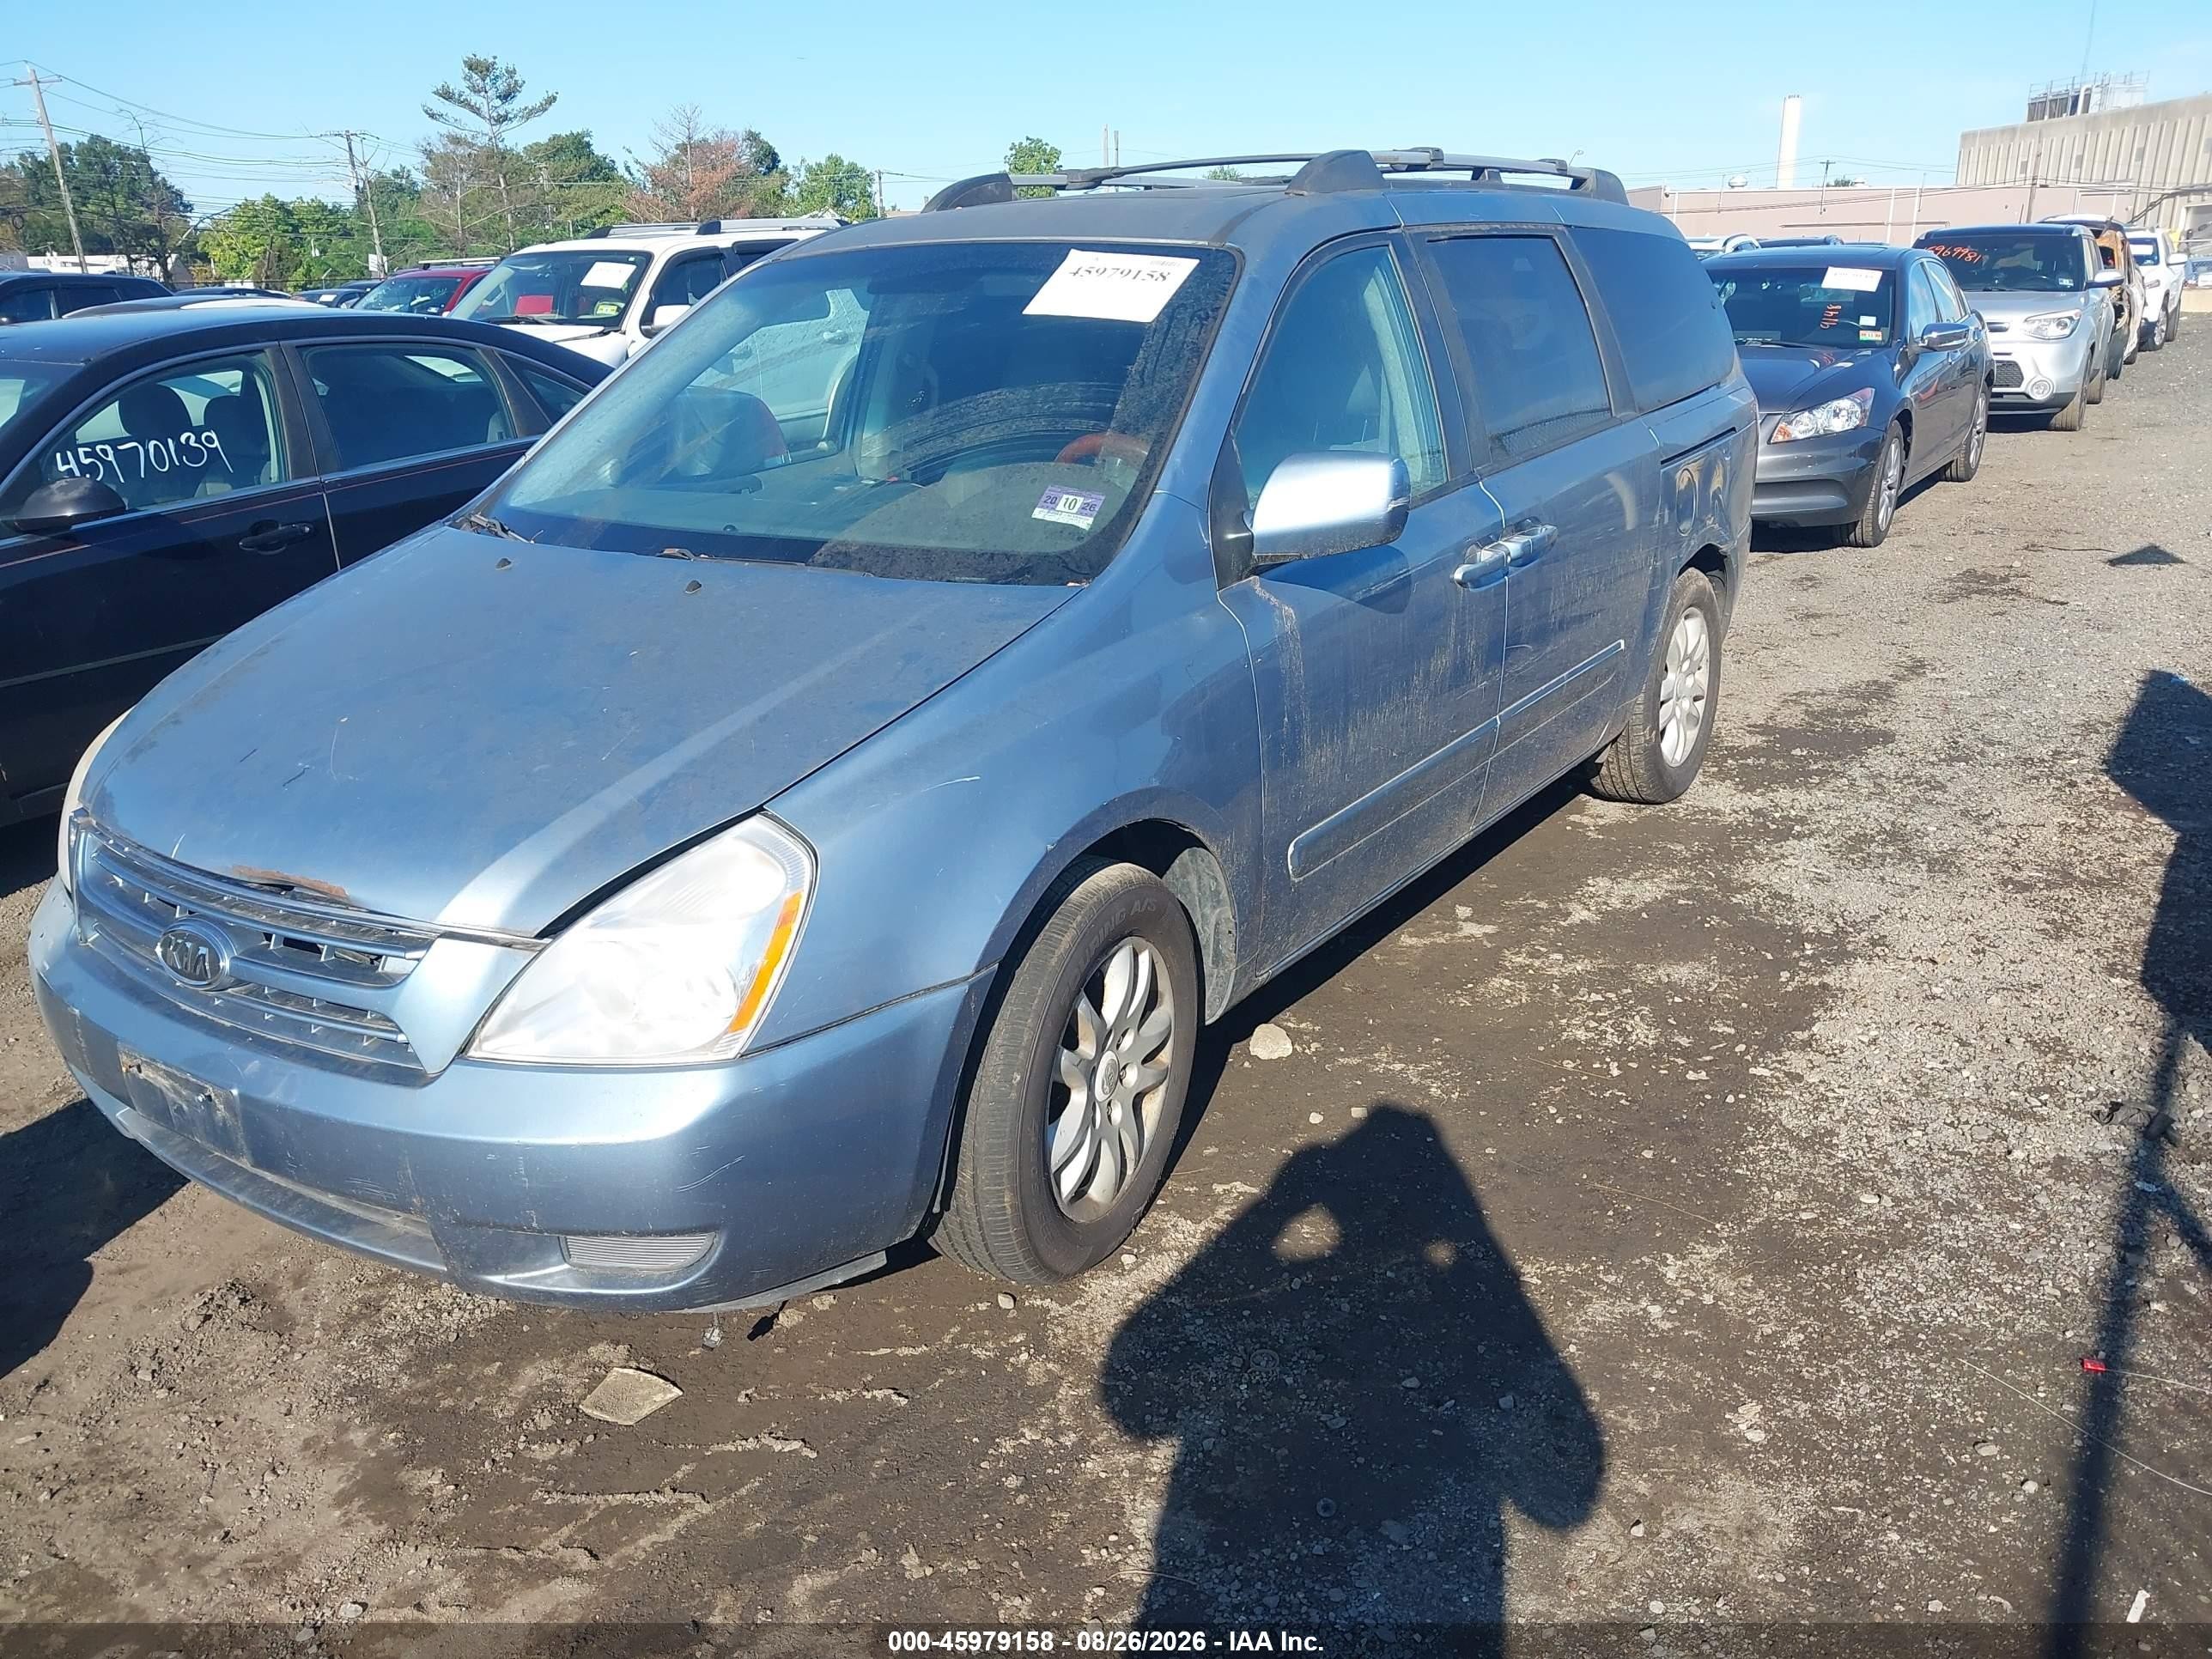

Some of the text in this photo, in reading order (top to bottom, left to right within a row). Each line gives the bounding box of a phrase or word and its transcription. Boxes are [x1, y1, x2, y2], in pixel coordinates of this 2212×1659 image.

[1068, 265, 1171, 283] 45979158
[55, 429, 234, 483] 45970139
[1044, 495, 1058, 505] 20
[1063, 497, 1078, 511] 10
[165, 933, 212, 980] KIA
